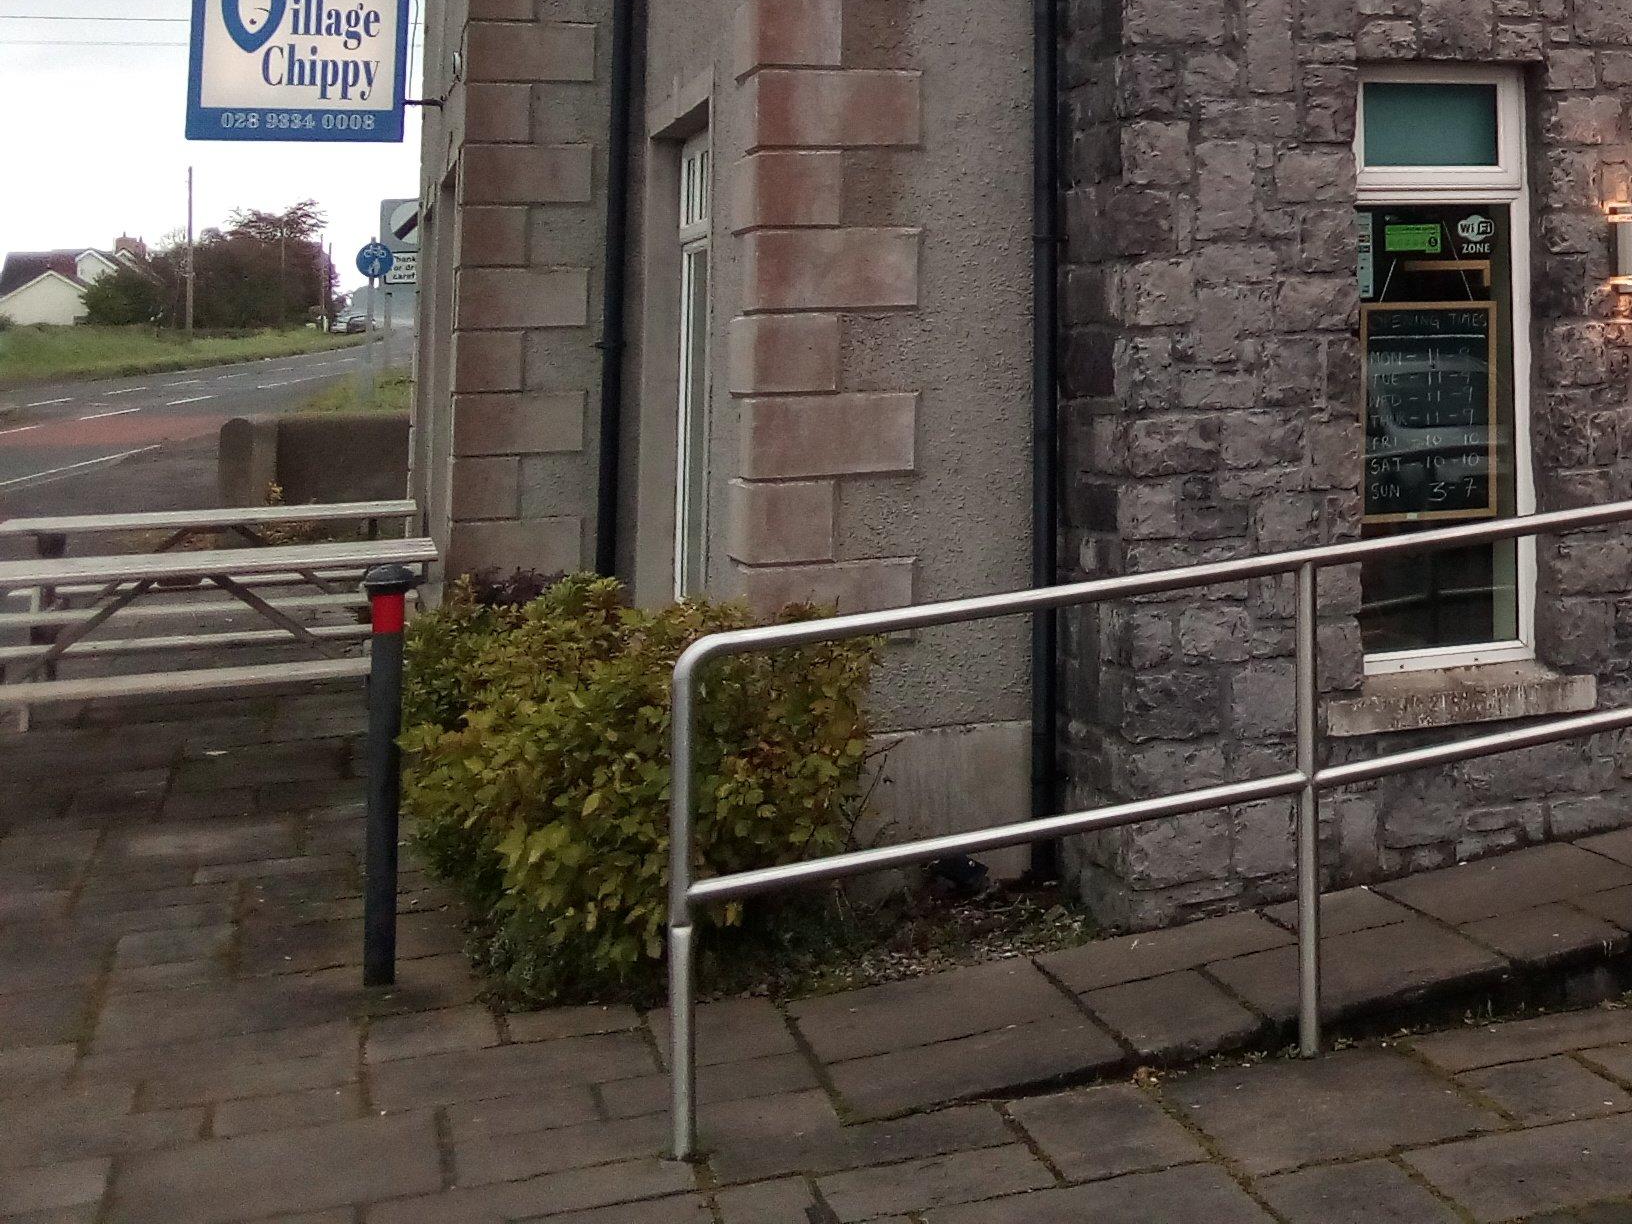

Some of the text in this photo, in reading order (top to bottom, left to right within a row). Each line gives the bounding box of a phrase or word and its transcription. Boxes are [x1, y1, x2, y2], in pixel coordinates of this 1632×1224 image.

[262, 43, 381, 101] Chippy
[220, 112, 376, 131] 028 9334 0008
[1461, 242, 1491, 254] ZONE
[393, 255, 417, 263] hank
[392, 272, 415, 280] caref
[1448, 312, 1487, 326] TIMES
[1370, 351, 1402, 366] MON
[1373, 372, 1399, 388] TUE
[1372, 435, 1398, 450] FRI
[1370, 457, 1402, 475] SAT
[1370, 482, 1400, 500] SUN
[1462, 477, 1476, 497] 7
